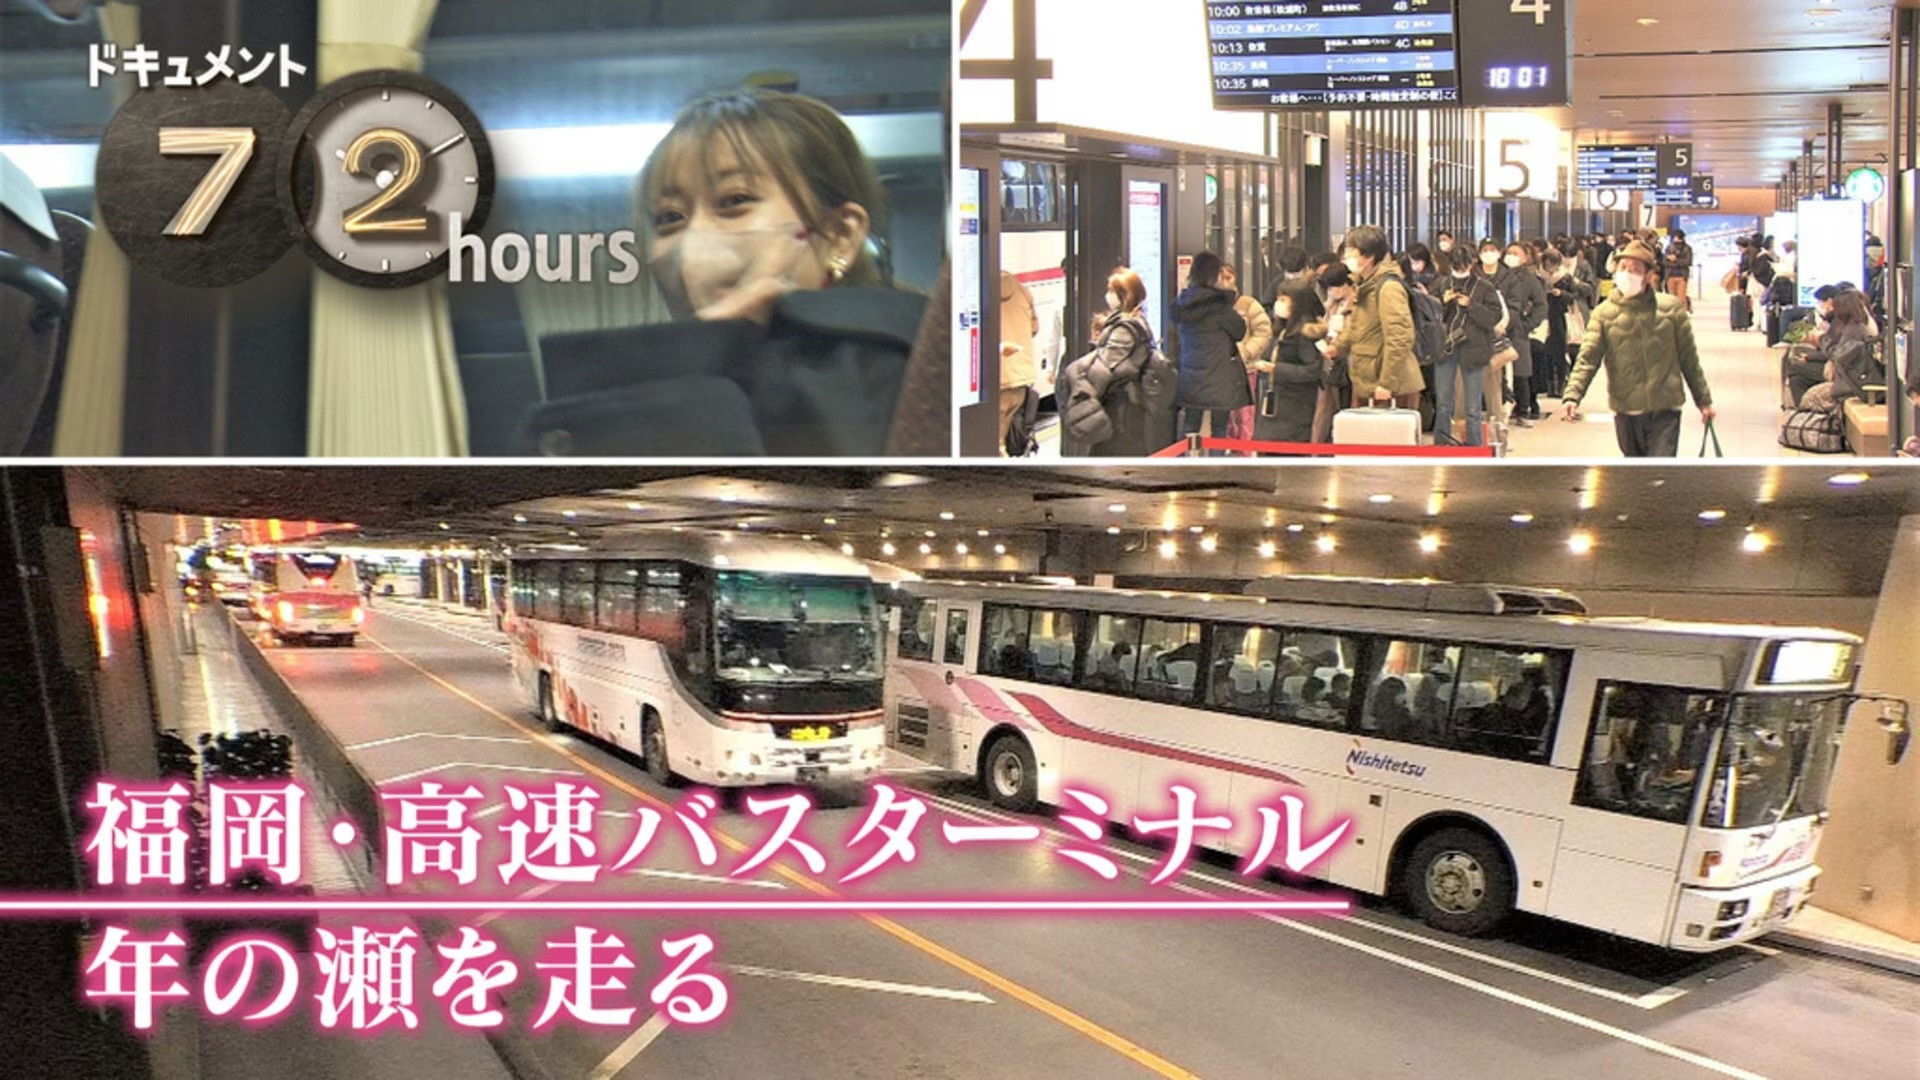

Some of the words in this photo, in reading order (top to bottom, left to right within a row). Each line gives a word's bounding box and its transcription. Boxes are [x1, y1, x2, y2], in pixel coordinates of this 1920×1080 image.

[1500, 138, 1530, 196] 5
[1675, 147, 1688, 167] 5
[1346, 749, 1428, 777] Nishitetsu
